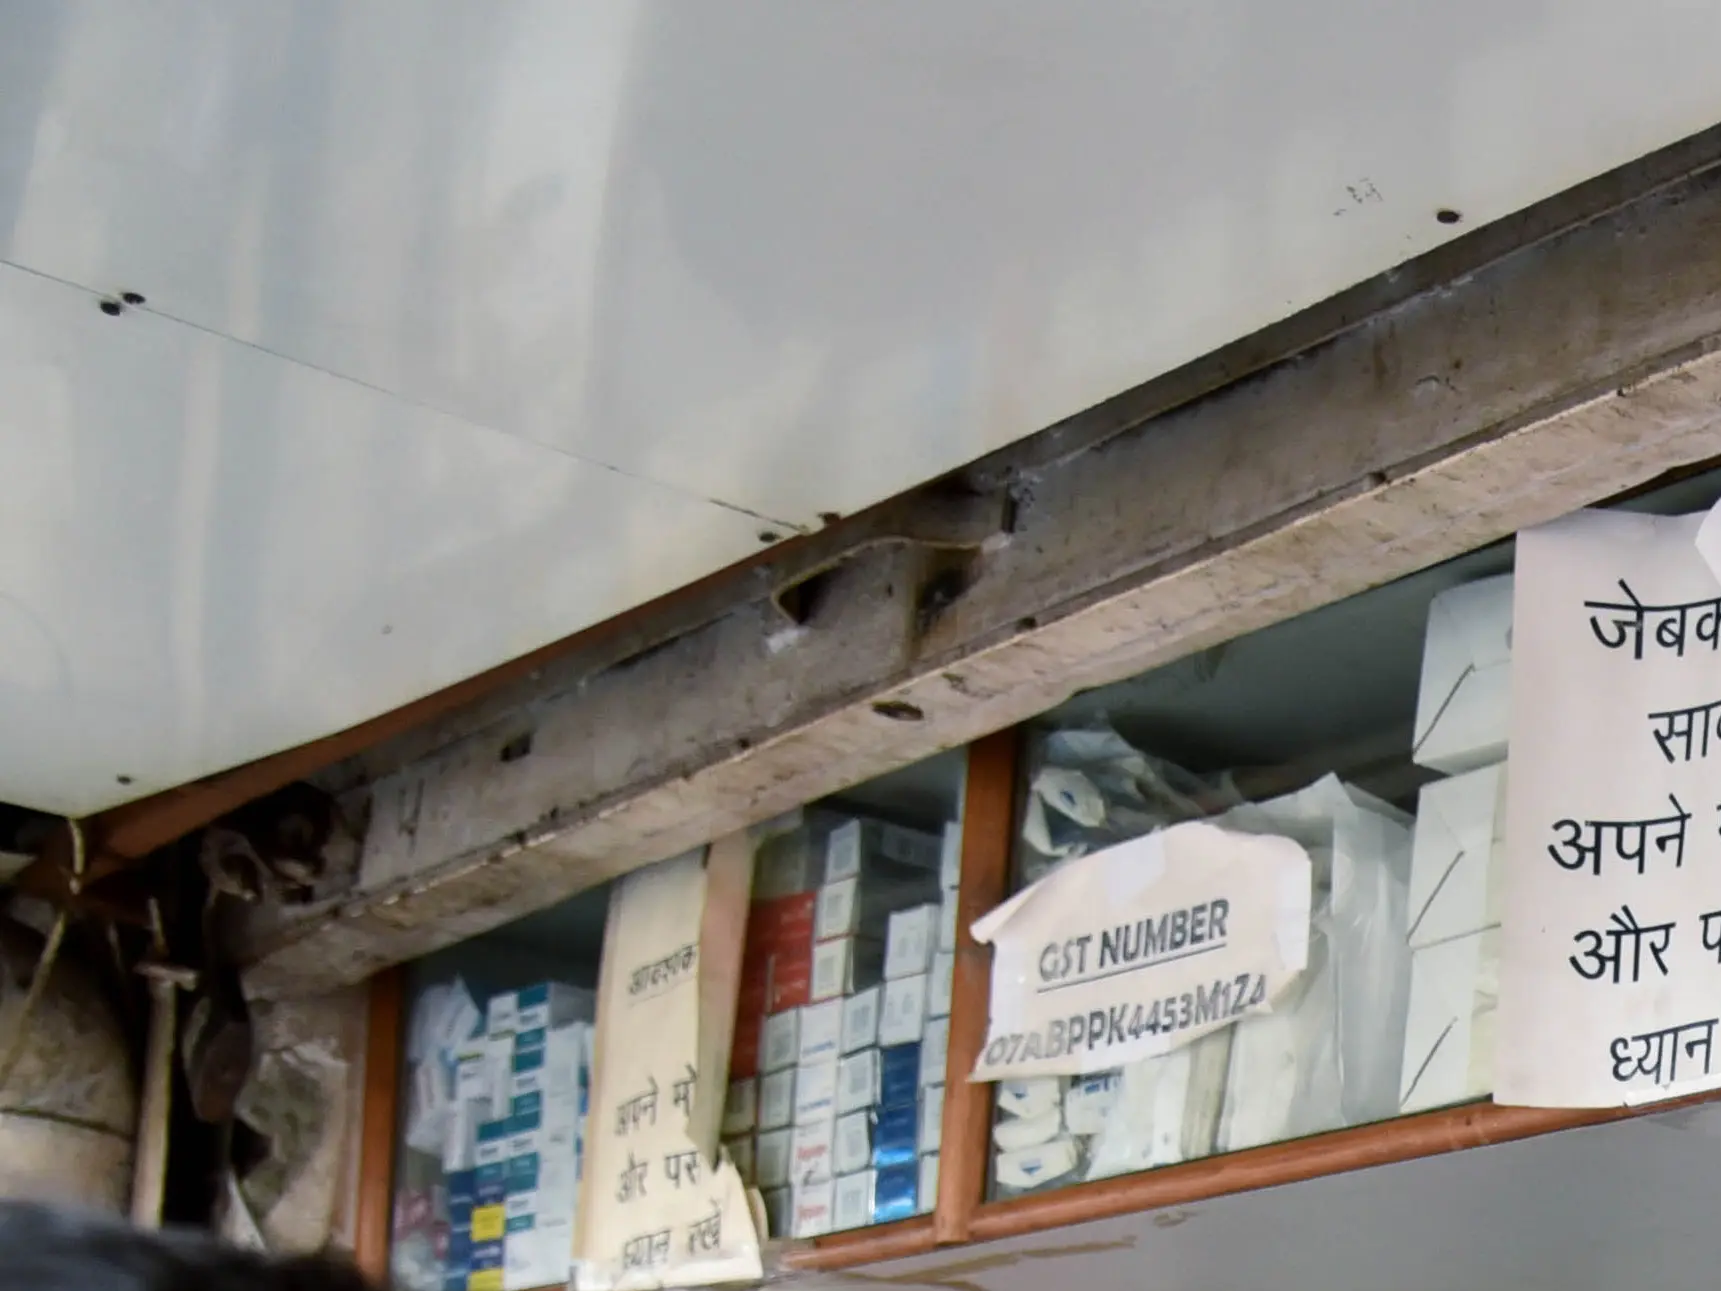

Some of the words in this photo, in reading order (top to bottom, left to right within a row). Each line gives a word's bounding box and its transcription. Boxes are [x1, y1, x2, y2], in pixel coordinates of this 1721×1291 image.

[1547, 793, 1691, 876] अपने
[1038, 935, 1093, 982] GST
[1098, 898, 1230, 966] NUMBER
[1569, 904, 1675, 984] और
[1610, 1017, 1718, 1086] ध्यान
